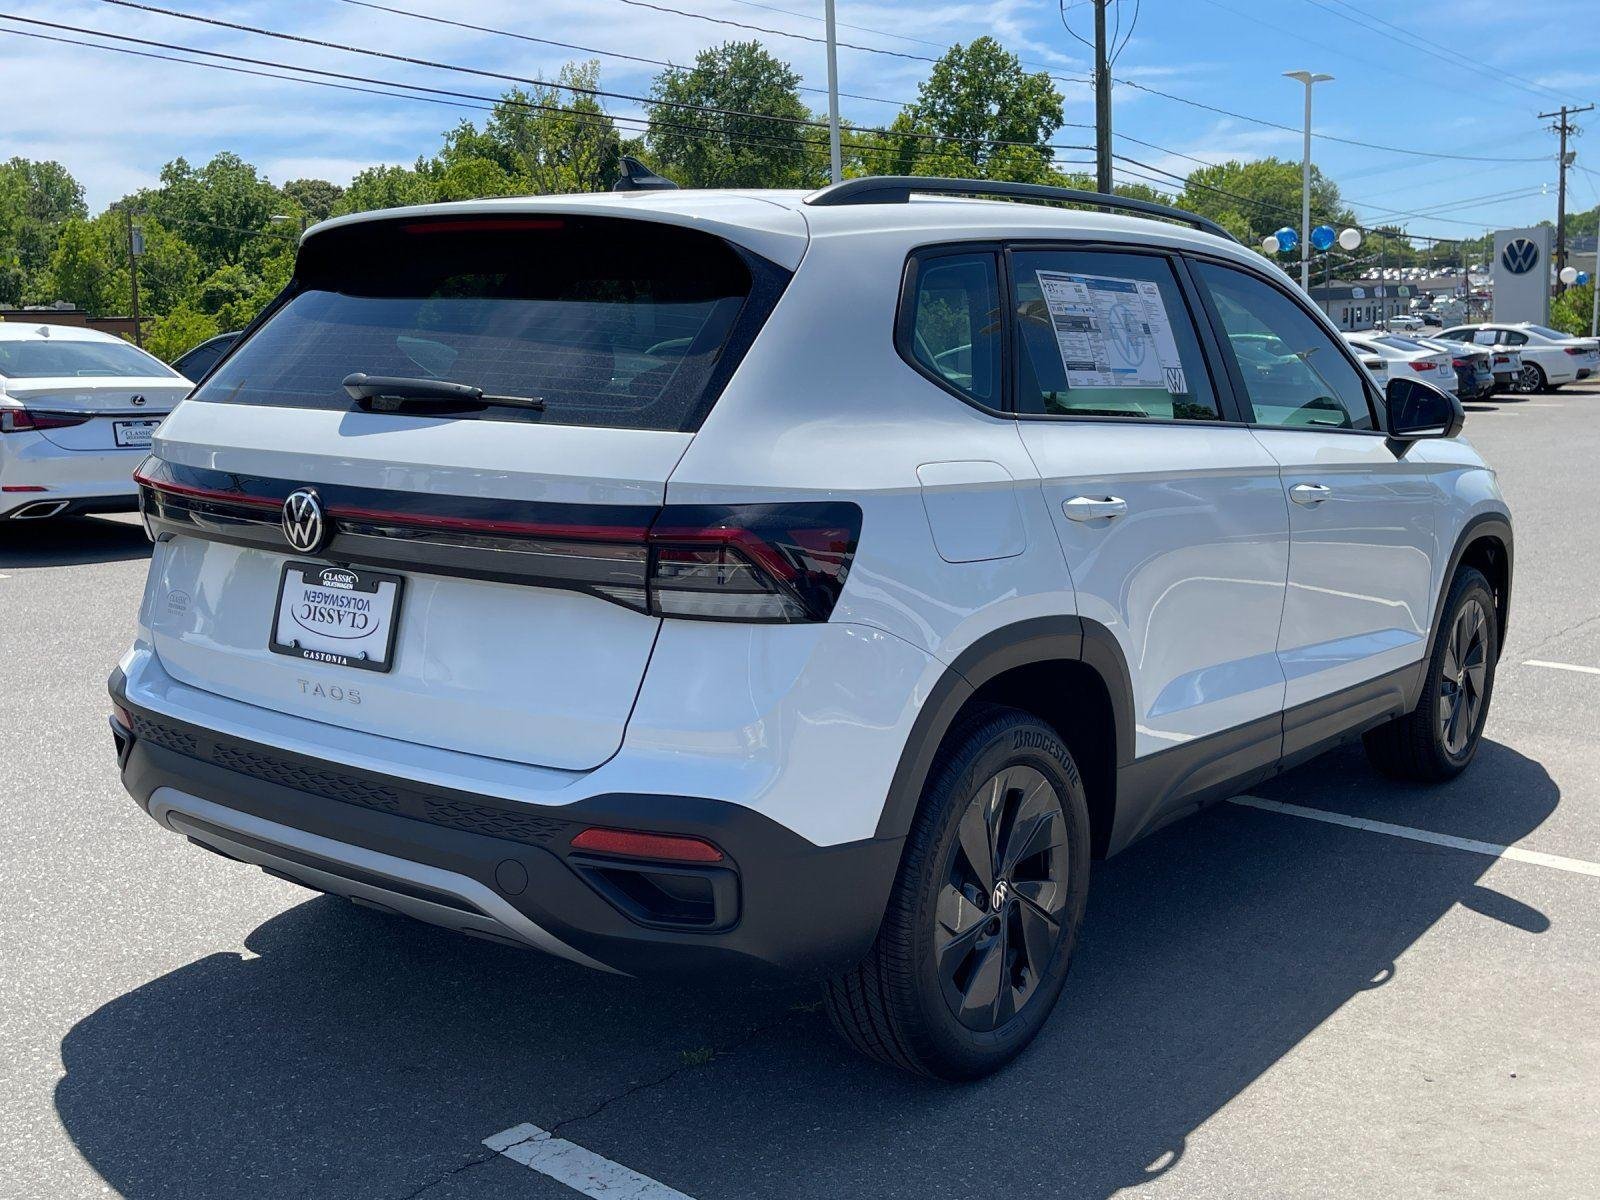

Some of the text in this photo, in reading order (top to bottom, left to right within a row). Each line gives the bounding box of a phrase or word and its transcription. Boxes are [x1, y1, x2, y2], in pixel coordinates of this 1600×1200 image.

[1502, 238, 1539, 274] VW
[282, 491, 322, 551] VW
[323, 580, 353, 590] VOLKSWAGEN
[324, 572, 354, 584] CLASSIC
[304, 590, 370, 612] VOLKSWAGEN
[300, 603, 368, 629] CLASSIC
[304, 650, 347, 665] GASTONIA
[298, 679, 362, 704] TAOS
[1012, 730, 1080, 791] BRIDGESTONE
